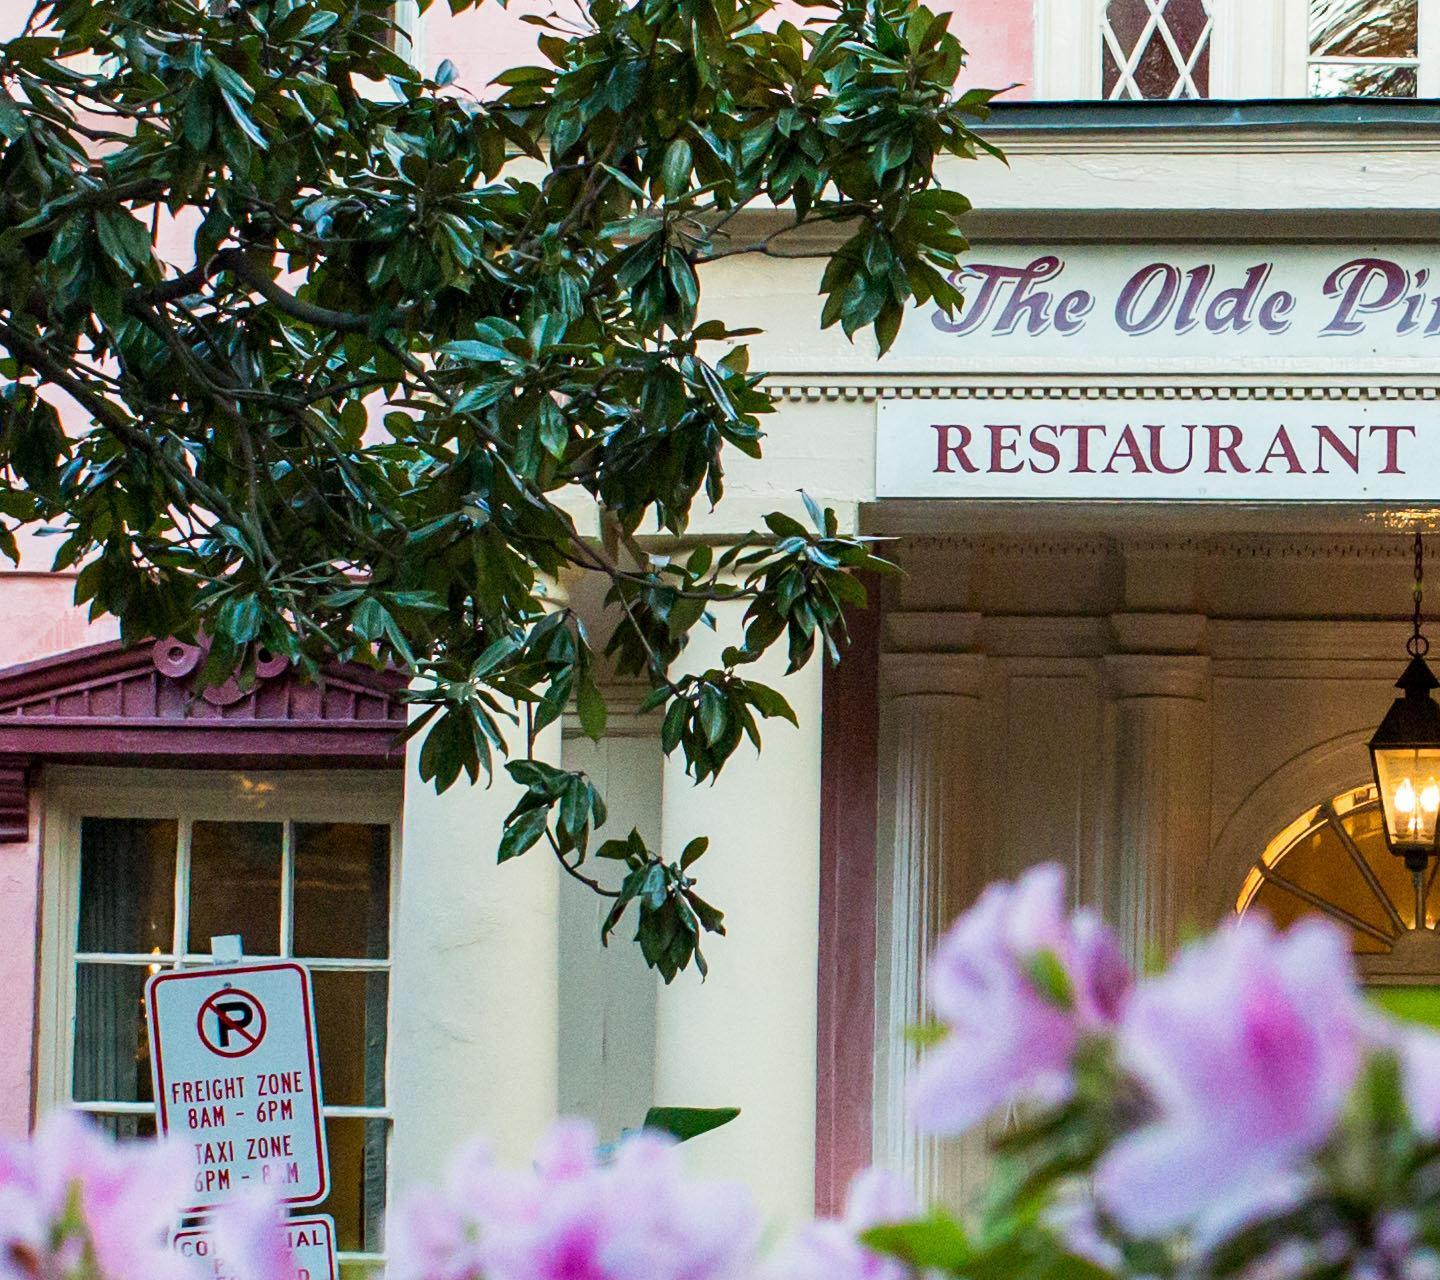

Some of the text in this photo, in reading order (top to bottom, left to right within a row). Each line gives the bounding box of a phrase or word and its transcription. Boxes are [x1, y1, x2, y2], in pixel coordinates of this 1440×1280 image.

[931, 255, 1095, 337] The
[1115, 262, 1296, 337] Olde
[931, 423, 1416, 475] RESTAURANT
[171, 1071, 304, 1104] FREIGHT ZONE
[188, 1105, 225, 1129] 8AM
[256, 1099, 294, 1123] 6PM
[194, 1135, 294, 1165] TAXI ZONE
[194, 1168, 231, 1192] 6PM
[262, 1162, 299, 1185] 8M
